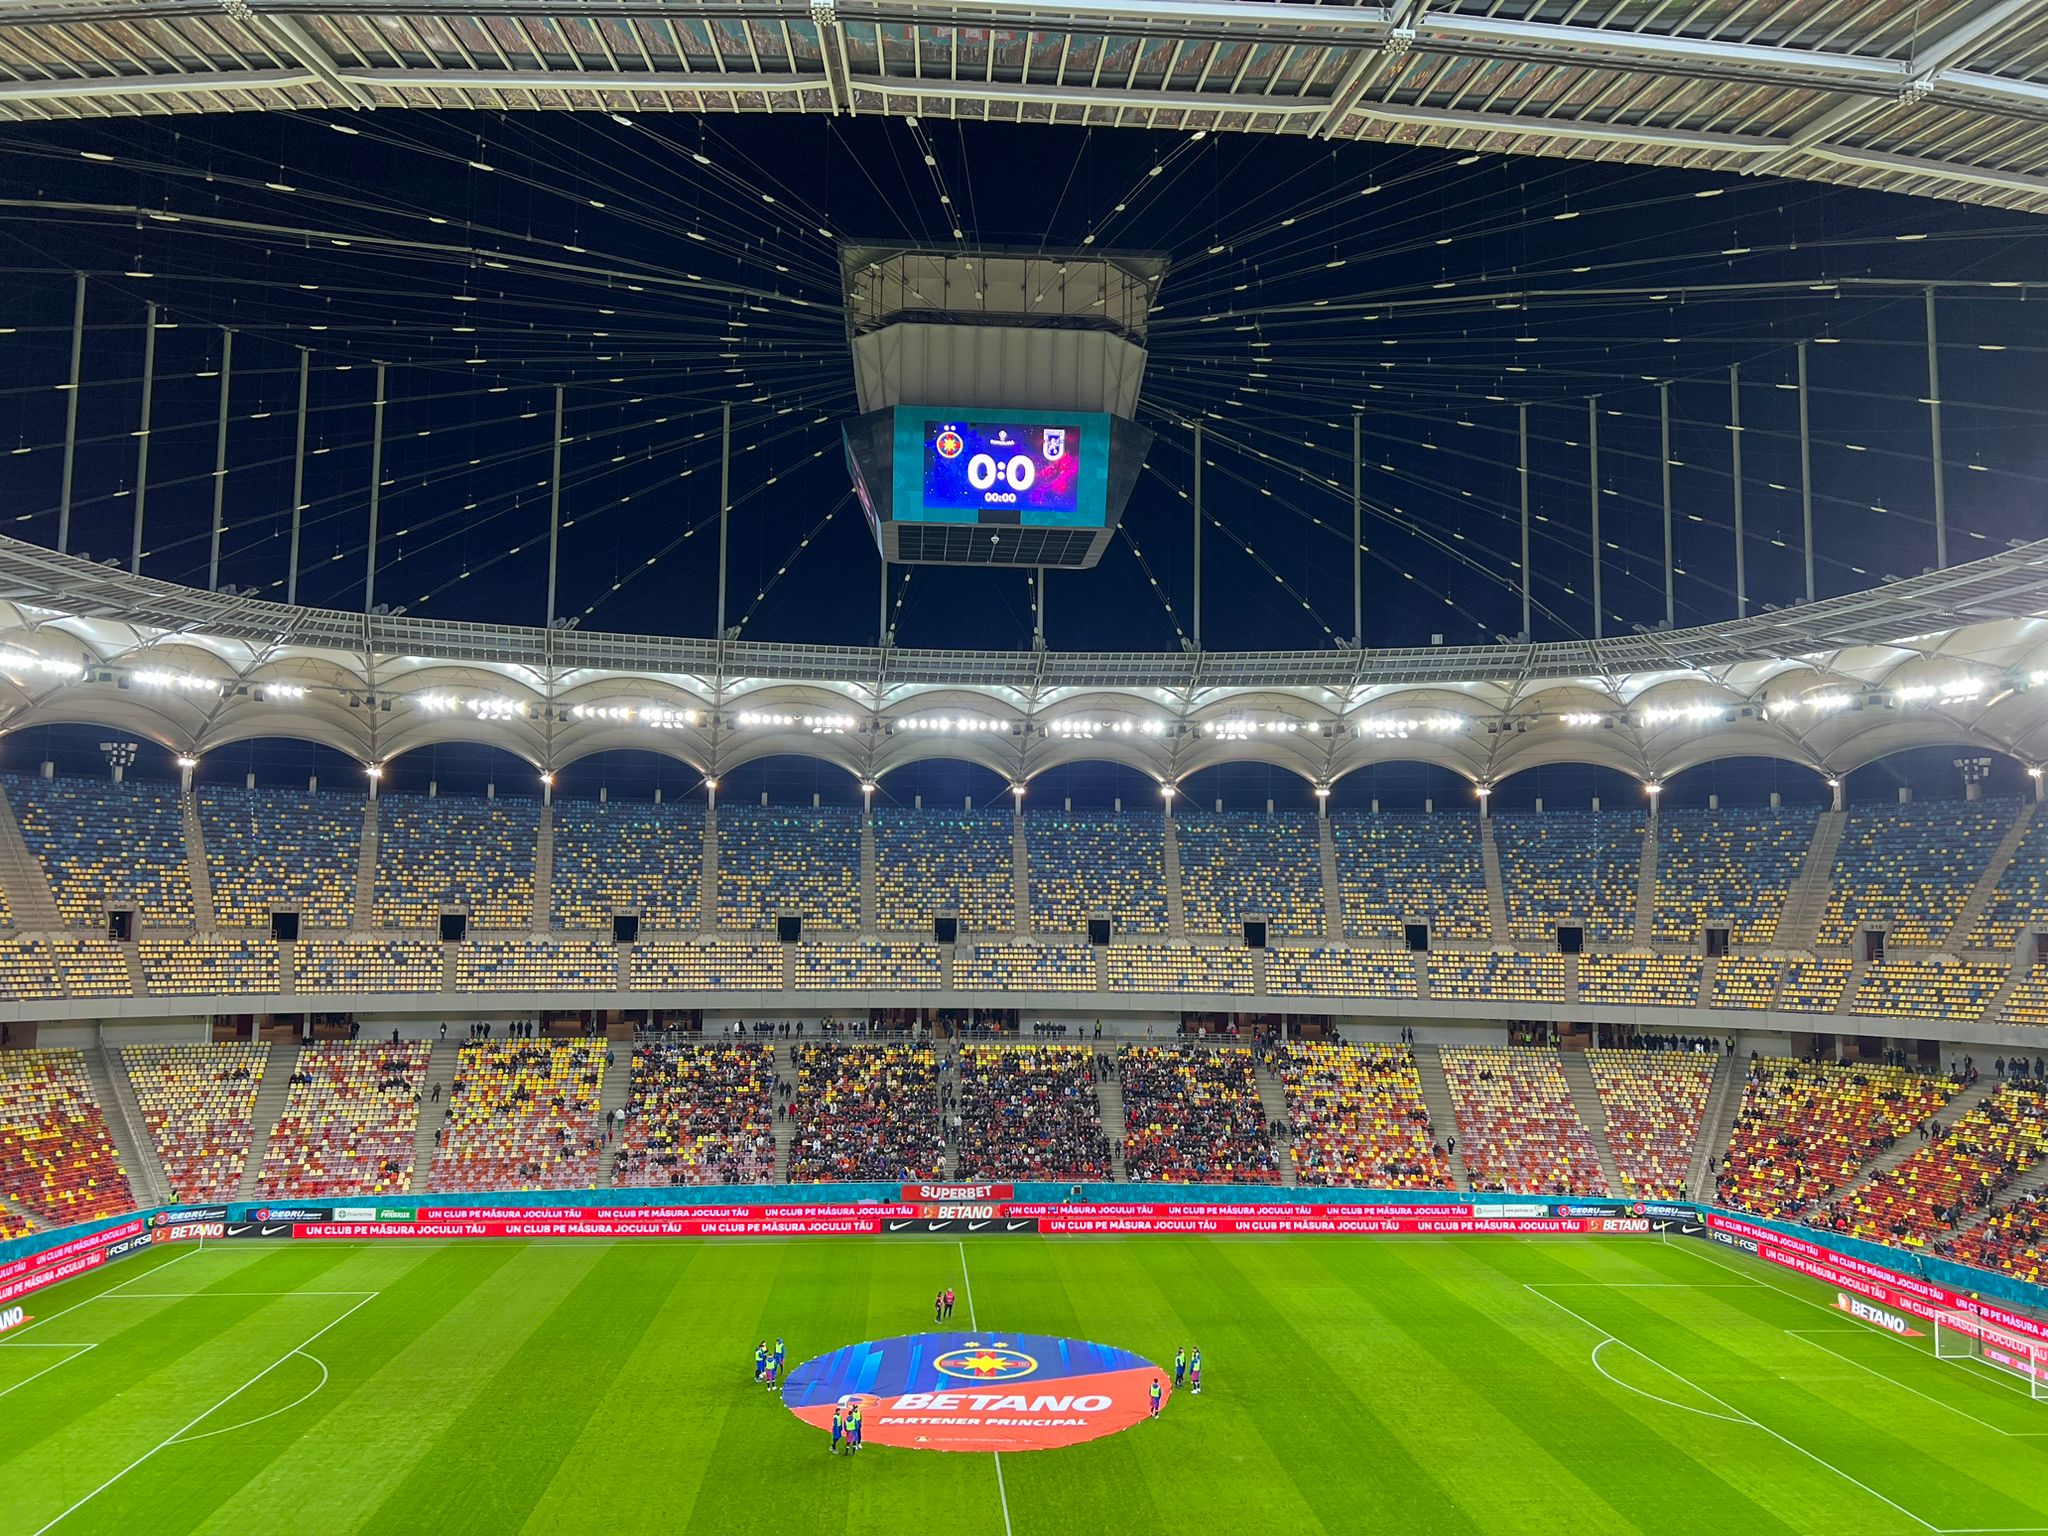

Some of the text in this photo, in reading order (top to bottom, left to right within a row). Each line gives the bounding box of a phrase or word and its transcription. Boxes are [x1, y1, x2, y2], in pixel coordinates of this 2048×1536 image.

[968, 454, 1035, 491] 0:0
[985, 492, 1016, 503] 00:00
[920, 1186, 992, 1199] SUPERBET
[170, 1210, 207, 1220] CEDRU
[270, 1210, 305, 1218] CEDRU
[443, 1210, 467, 1218] CLUB
[469, 1210, 480, 1218] PE
[523, 1210, 562, 1218] JOCULUI
[598, 1210, 611, 1218] UN
[612, 1210, 636, 1218] CLUB
[779, 1208, 803, 1216] CLUB
[856, 1207, 894, 1215] JOCULUI
[938, 1206, 993, 1219] BETANO
[1008, 1206, 1022, 1214] UN
[1024, 1206, 1046, 1214] CLUB
[1048, 1206, 1058, 1214] PE
[1098, 1206, 1135, 1214] JOCULUI
[1182, 1206, 1204, 1214] CLUB
[1646, 1206, 1678, 1215] CEDRU
[306, 1226, 322, 1235] UN
[324, 1226, 352, 1234] CLUB
[354, 1226, 368, 1234] PE
[417, 1225, 462, 1234] JOCULUI
[506, 1225, 521, 1233] UN
[523, 1224, 550, 1233] CLUB
[553, 1224, 566, 1233] PE
[614, 1224, 659, 1233] JOCULUI
[701, 1224, 716, 1232] UN
[718, 1223, 745, 1232] CLUB
[747, 1223, 760, 1232] PE
[807, 1222, 851, 1231] JOCULUI
[1051, 1221, 1065, 1230] UN
[1067, 1221, 1093, 1230] CLUB
[1095, 1221, 1107, 1229] PE
[1154, 1221, 1196, 1229] JOCULUI
[1236, 1222, 1250, 1230] UN
[1252, 1221, 1277, 1230] CLUB
[1279, 1221, 1291, 1230] PE
[1337, 1222, 1378, 1230] JOCULUI
[1418, 1222, 1432, 1230] UN
[1434, 1222, 1459, 1230] CLUB
[1461, 1222, 1473, 1230] PE
[1518, 1222, 1559, 1230] JOCULUI
[1603, 1219, 1649, 1231] BETANO
[170, 1224, 224, 1239] BETANO
[1714, 1231, 1758, 1252] FCSB FCSB
[1900, 1298, 1911, 1309] UN
[1956, 1298, 1968, 1309] UN
[1990, 1310, 2001, 1322] PE
[1851, 1299, 1905, 1333] BETANO
[890, 1393, 1113, 1412] BETANO
[878, 1417, 1089, 1426] PARTENER PRINCIPAL
